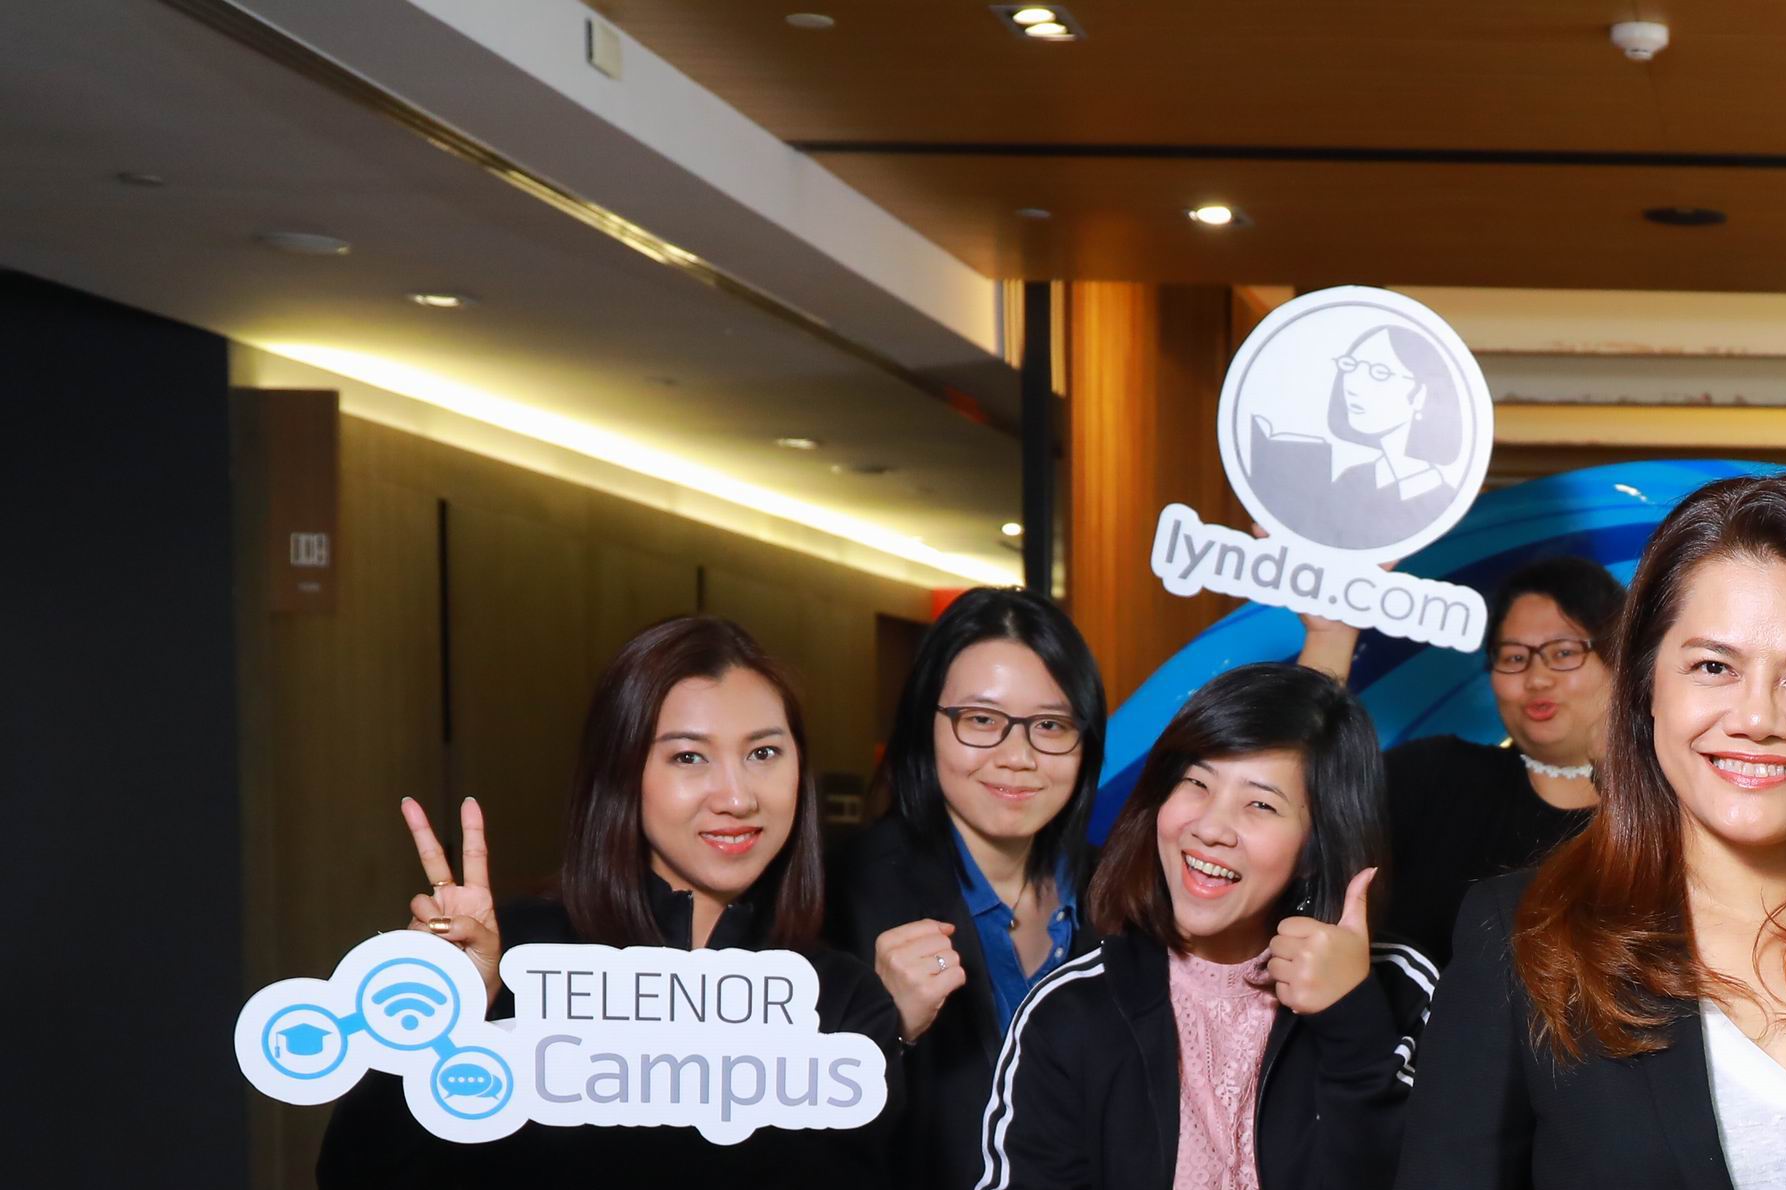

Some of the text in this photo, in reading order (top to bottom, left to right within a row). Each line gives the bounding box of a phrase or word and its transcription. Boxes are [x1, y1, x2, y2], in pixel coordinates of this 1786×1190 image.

[1165, 519, 1471, 637] lynda.com
[526, 969, 795, 1026] TELENOR
[533, 1033, 865, 1122] Campus
